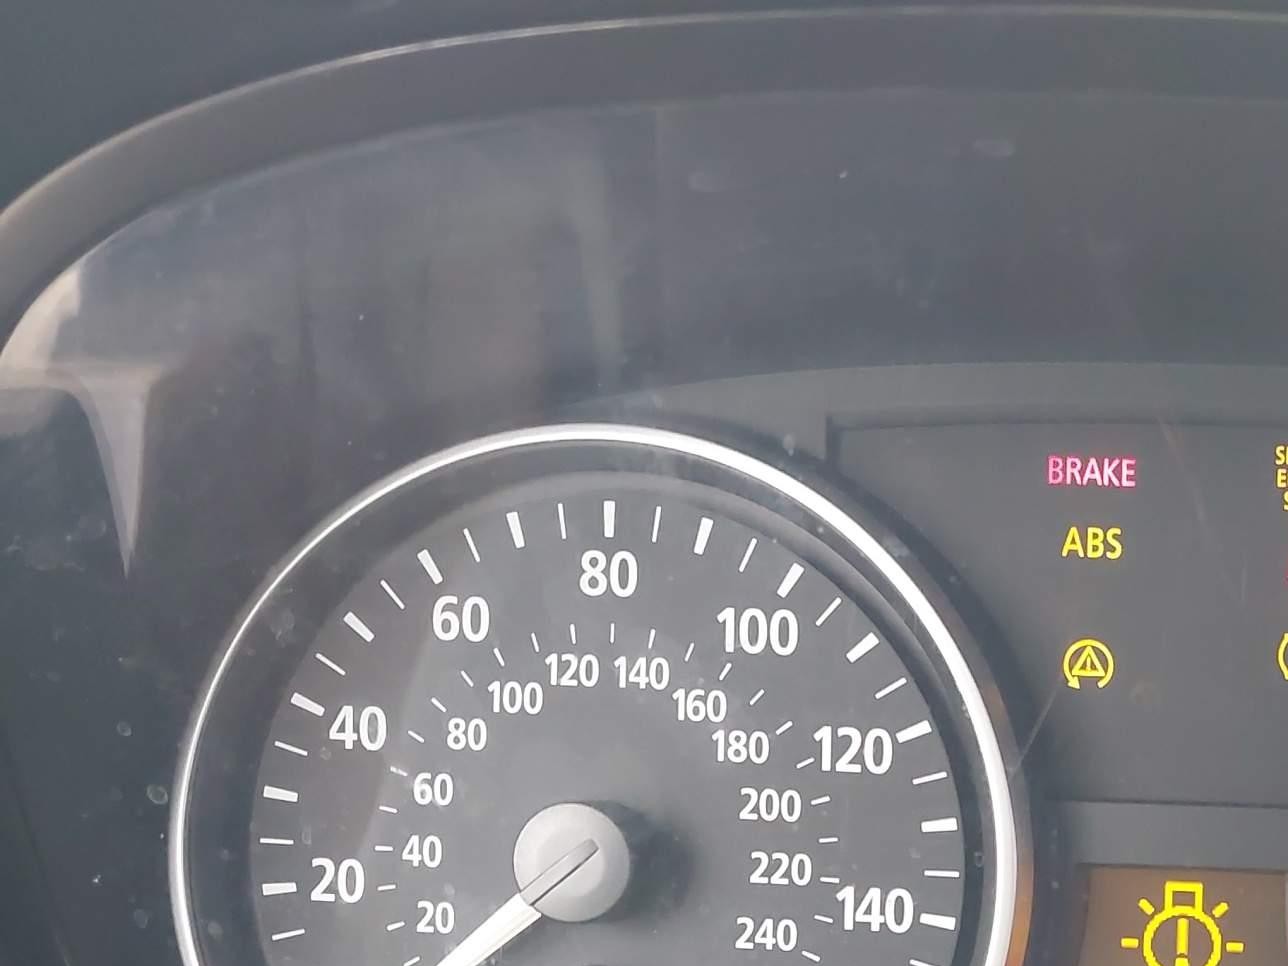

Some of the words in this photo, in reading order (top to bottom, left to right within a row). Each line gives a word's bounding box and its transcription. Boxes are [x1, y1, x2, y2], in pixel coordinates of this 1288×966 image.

[1048, 456, 1136, 487] BRAKE
[1061, 527, 1123, 559] ABS
[579, 549, 638, 598] 80
[431, 595, 490, 643] 60
[717, 607, 798, 655] 100
[545, 654, 599, 688] 120
[613, 656, 670, 690] 140
[488, 681, 543, 714] 100
[672, 688, 727, 723] 160
[329, 705, 388, 752] 40
[446, 719, 488, 751] 80
[712, 729, 769, 764] 180
[813, 725, 893, 774] 120
[413, 774, 454, 806] 60
[739, 787, 801, 822] 200
[402, 836, 443, 867] 40
[749, 851, 812, 886] 220
[310, 857, 364, 903] 20
[416, 902, 455, 933] 20
[835, 887, 914, 934] 140
[735, 918, 798, 951] 240
